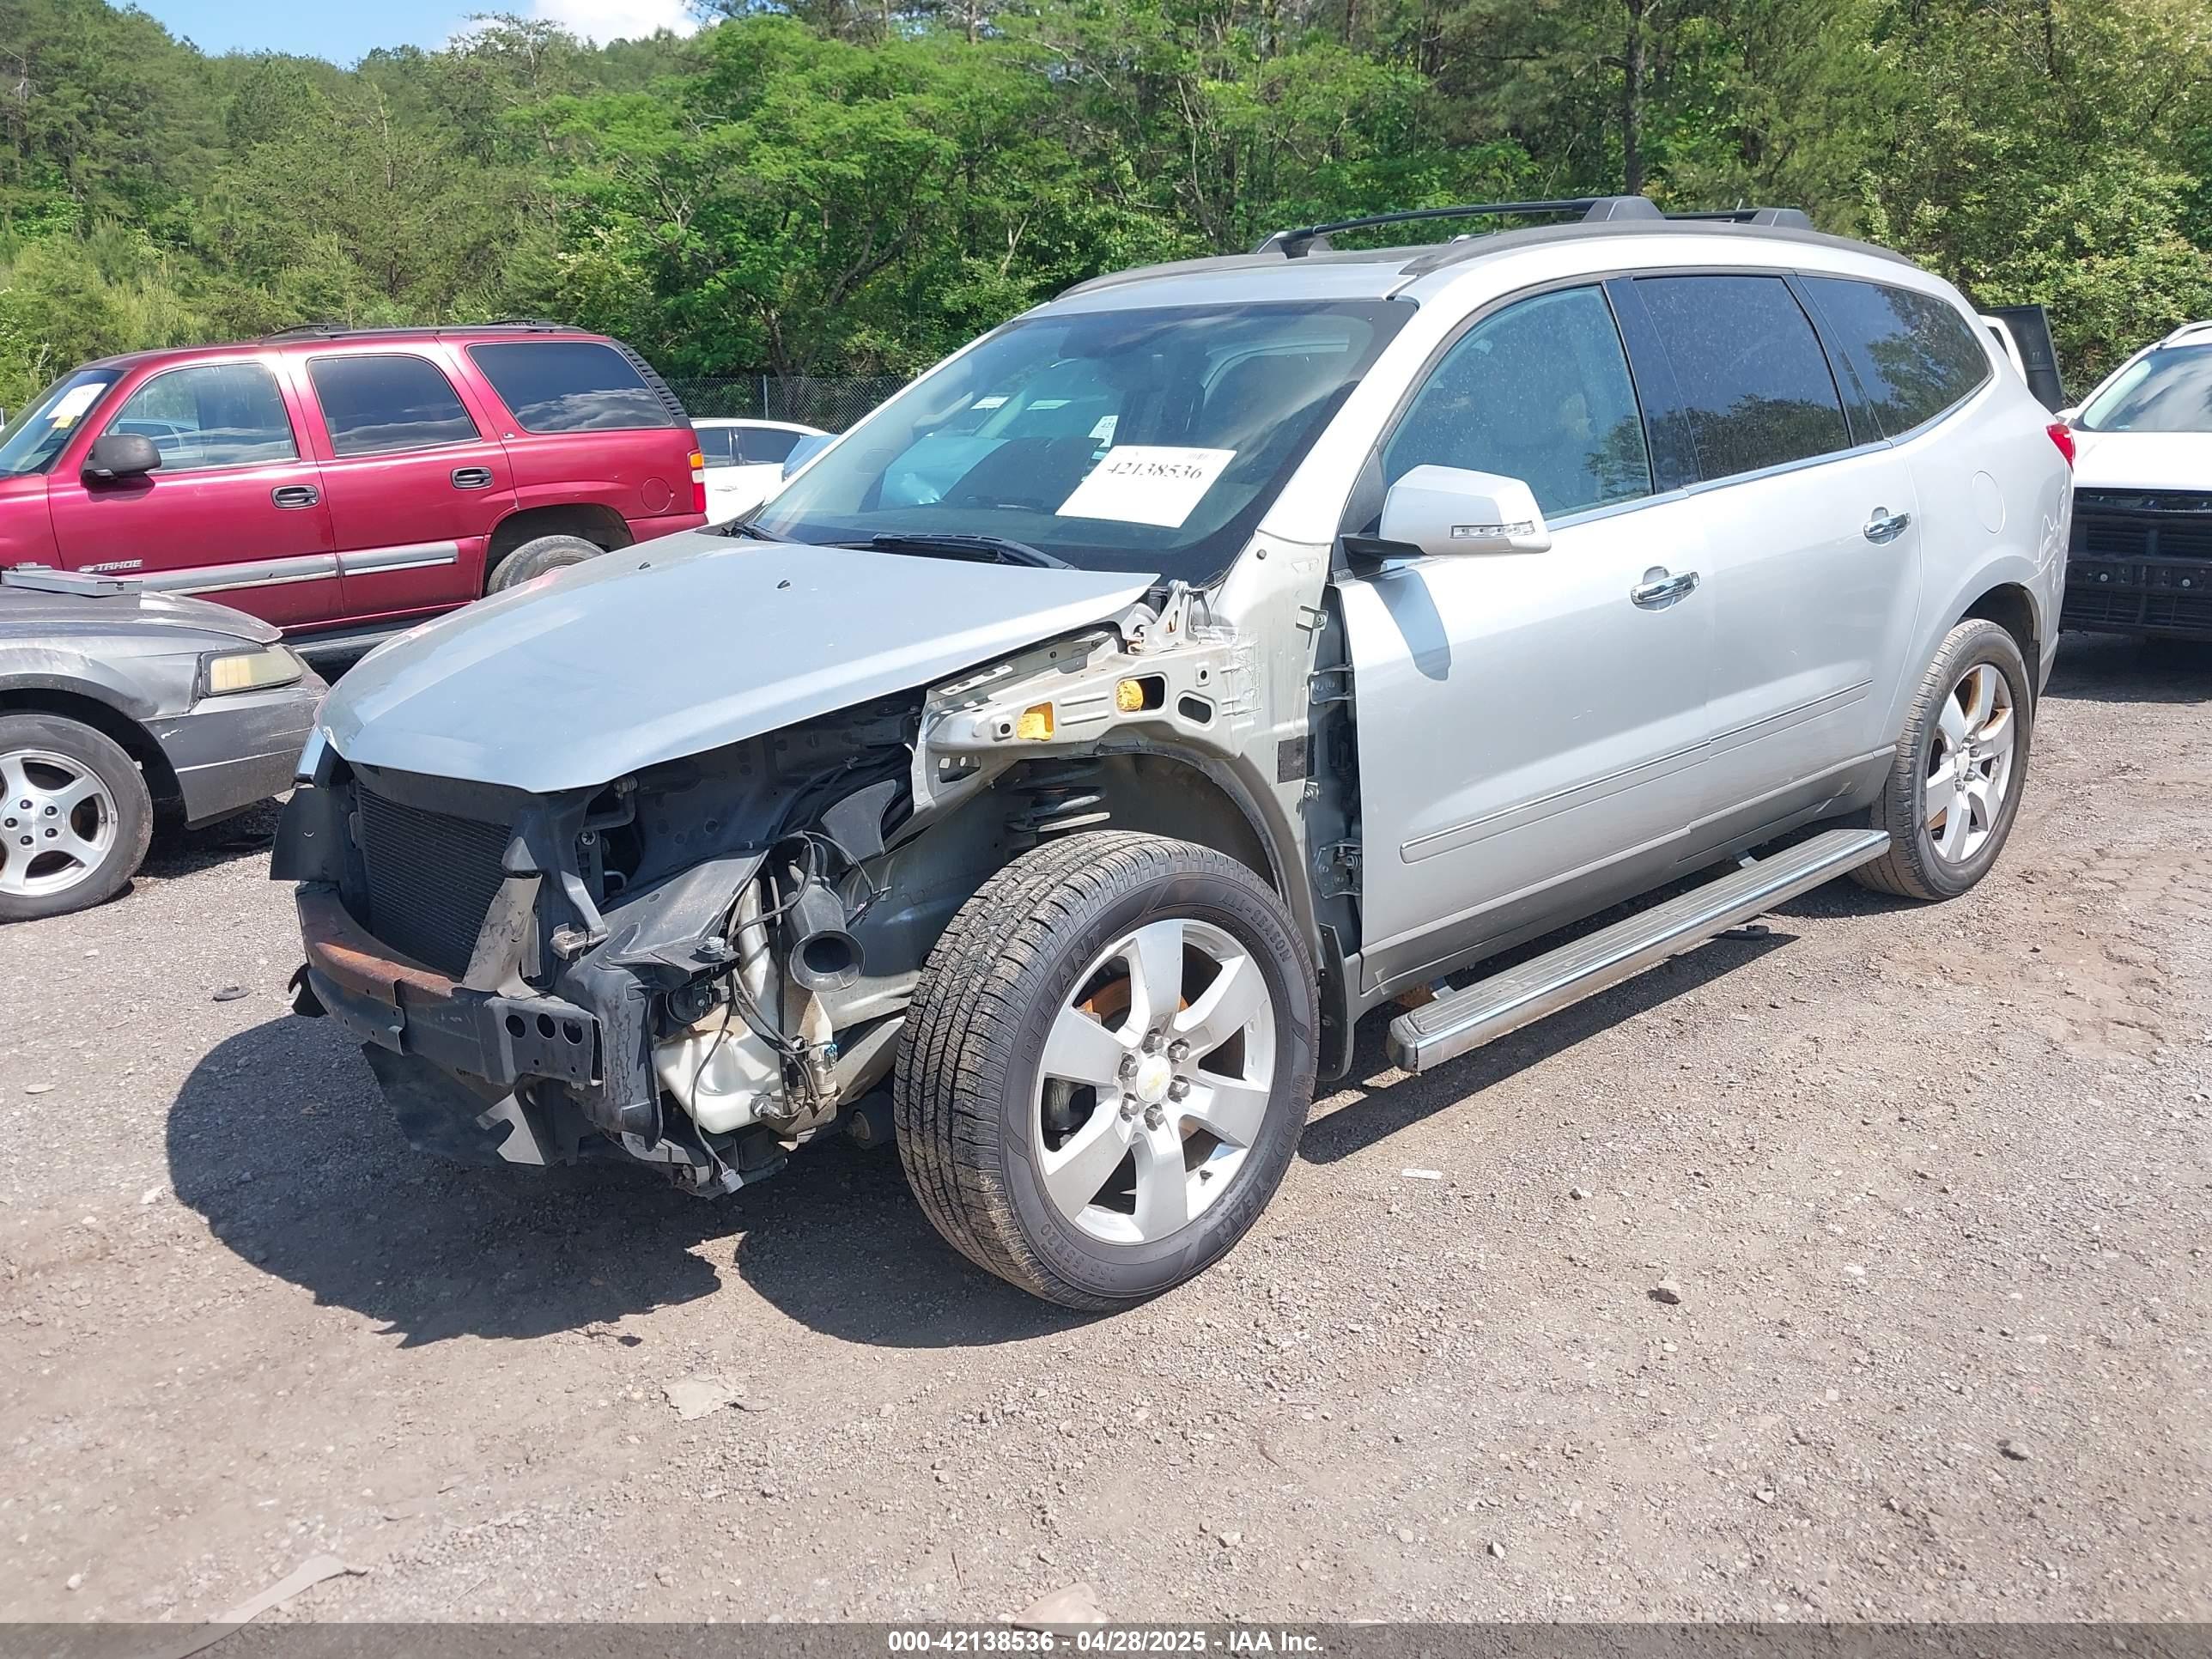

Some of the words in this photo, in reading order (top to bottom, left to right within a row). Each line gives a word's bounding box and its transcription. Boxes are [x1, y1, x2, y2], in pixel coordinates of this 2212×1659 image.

[1107, 462, 1203, 480] 42138536
[97, 559, 143, 572] TAHOE
[1218, 891, 1292, 963] ALL-SEASON
[1020, 923, 1103, 1065] RELIANT
